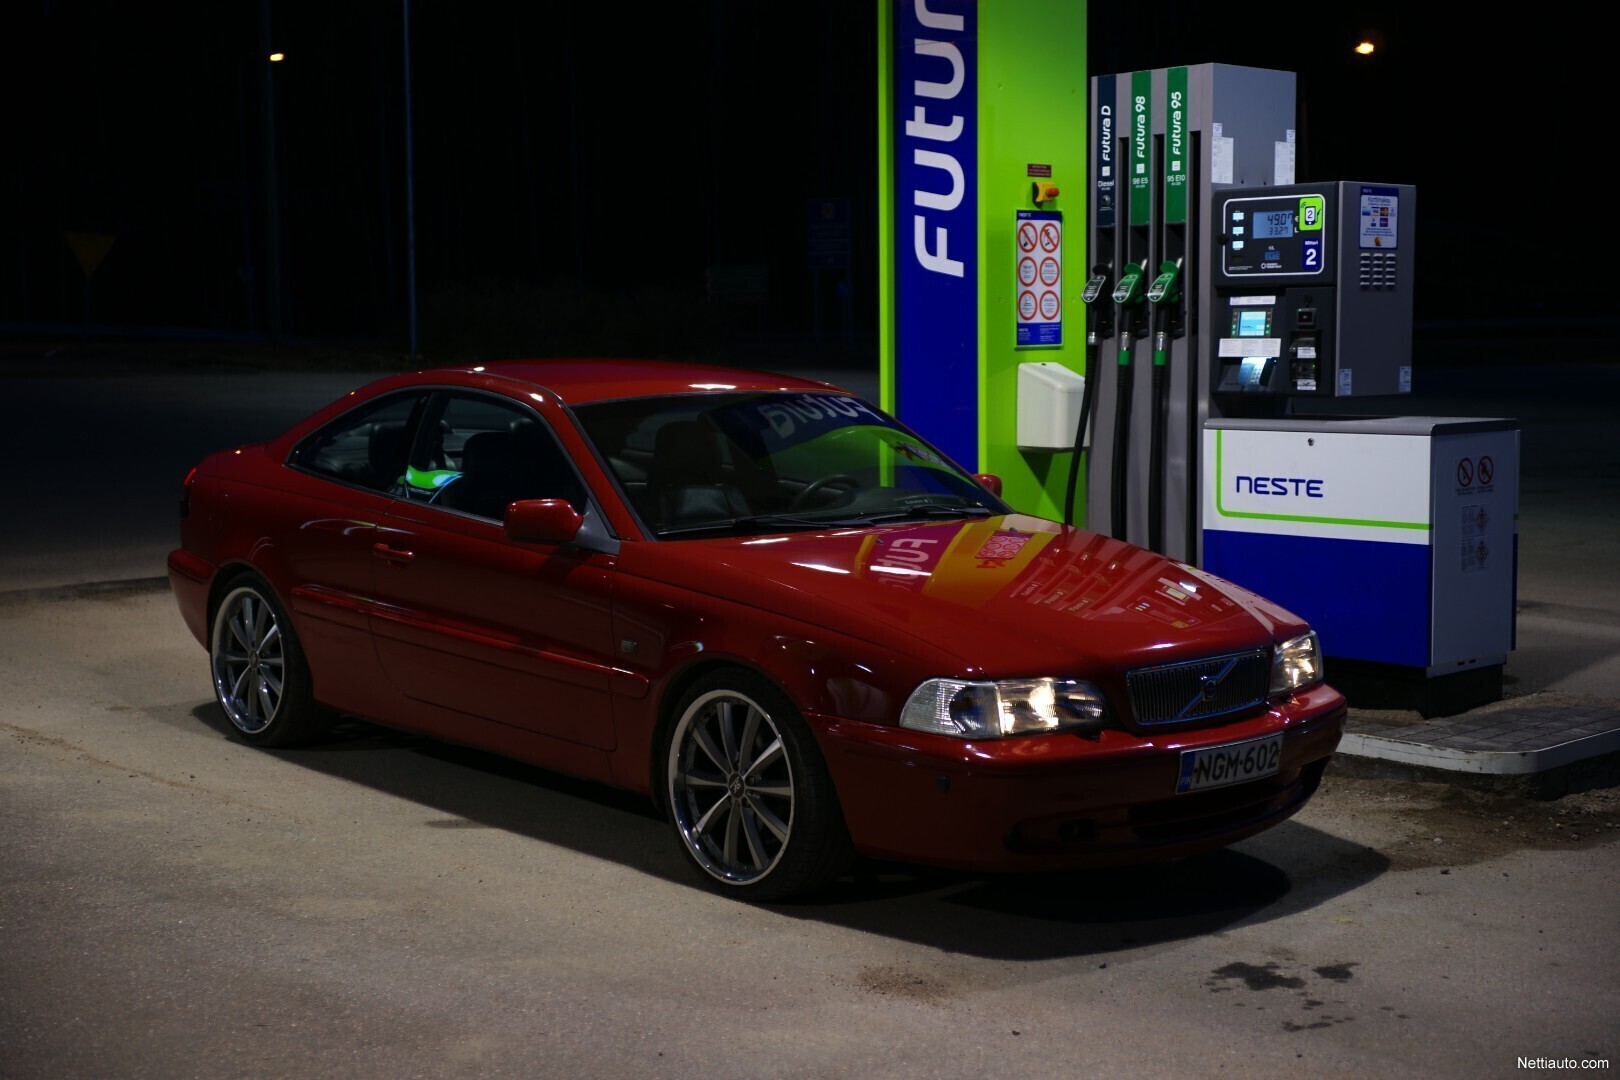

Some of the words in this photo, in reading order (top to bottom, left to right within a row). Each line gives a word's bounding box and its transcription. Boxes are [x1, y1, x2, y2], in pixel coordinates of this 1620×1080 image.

[1135, 95, 1146, 113] 98
[1171, 91, 1182, 109] 95
[1101, 105, 1111, 115] D
[1102, 118, 1111, 161] Futura
[1135, 115, 1146, 158] Futura
[1172, 111, 1182, 155] Futura
[1097, 180, 1115, 188] Diesel
[1175, 174, 1186, 182] E10
[1307, 210, 1314, 219] 2
[1305, 248, 1317, 266] 2
[1235, 475, 1324, 498] NESTE
[1195, 741, 1279, 785] NGM-602
